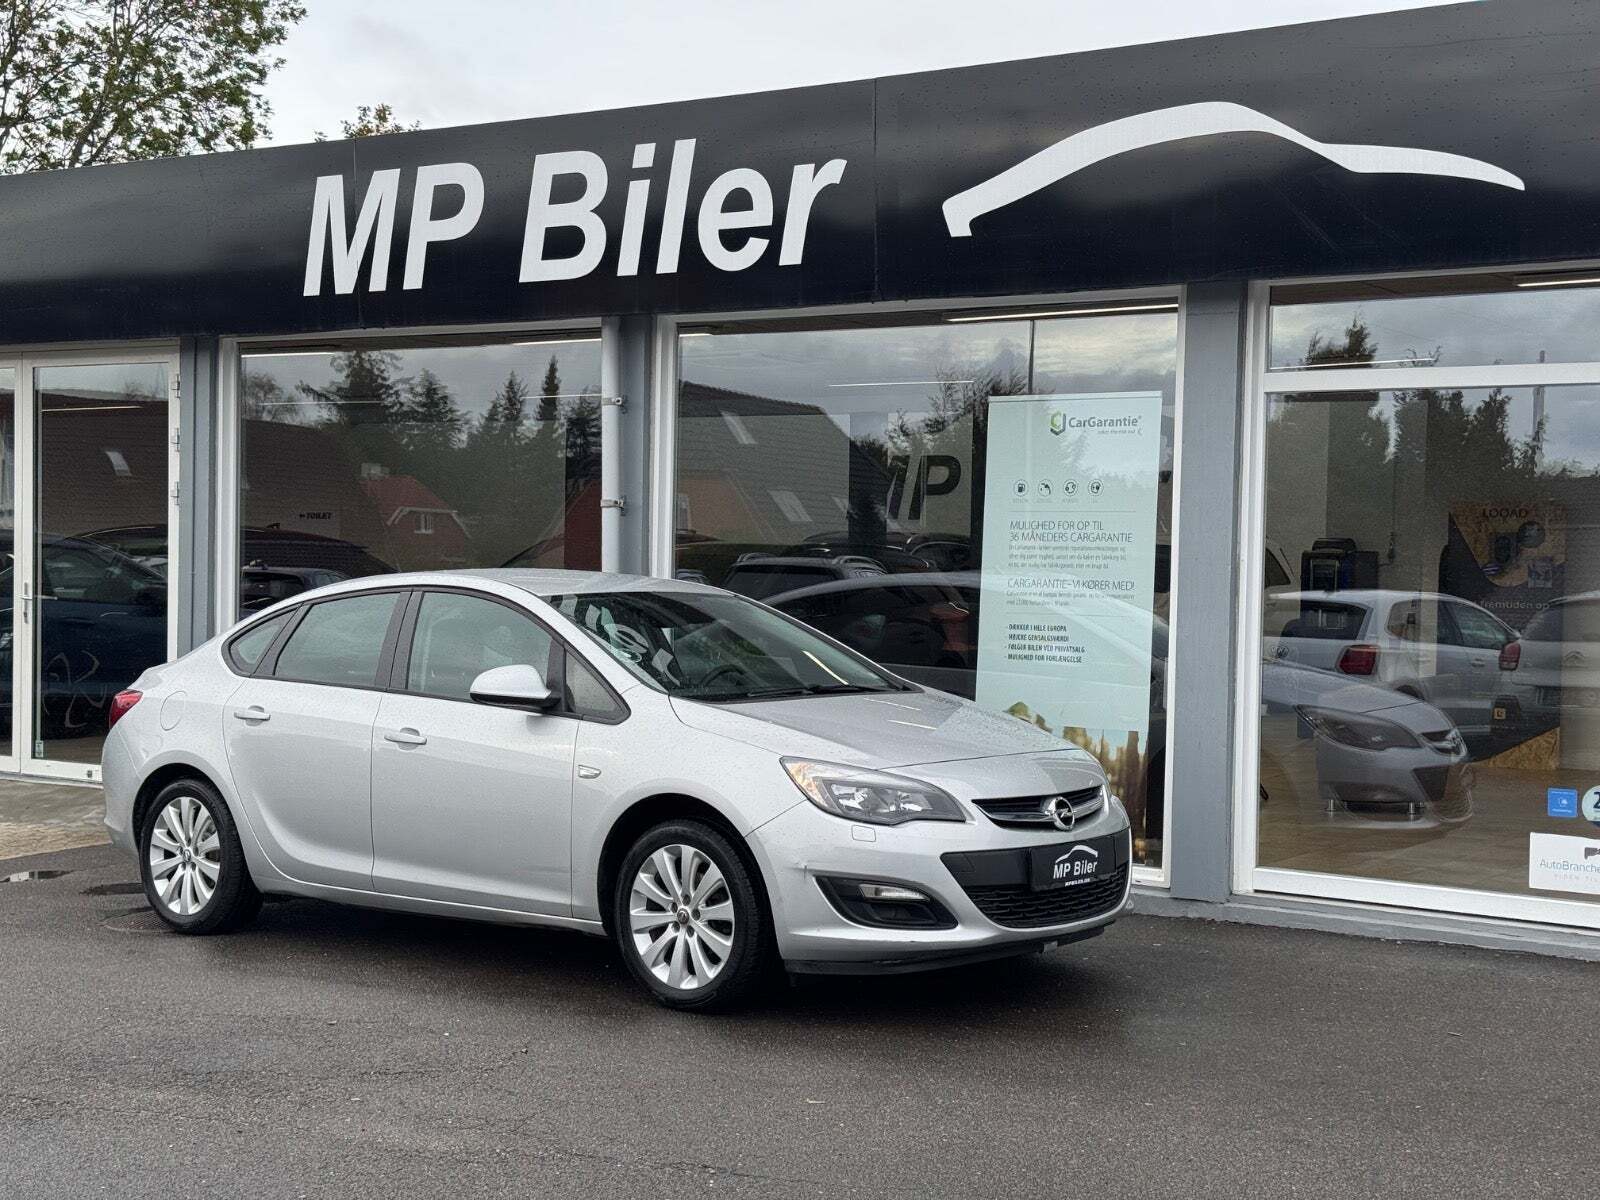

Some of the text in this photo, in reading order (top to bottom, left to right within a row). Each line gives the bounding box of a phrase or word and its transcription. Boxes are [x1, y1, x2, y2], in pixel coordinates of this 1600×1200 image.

[303, 138, 847, 296] MP Biler
[1068, 416, 1138, 428] CarGarantie
[306, 512, 332, 520] TOILET
[1009, 520, 1104, 531] MULIGHED FOR OP TIL
[1010, 530, 1133, 543] 36 MÅNEDERS CARGARANTIE
[1053, 860, 1098, 879] MP Biler
